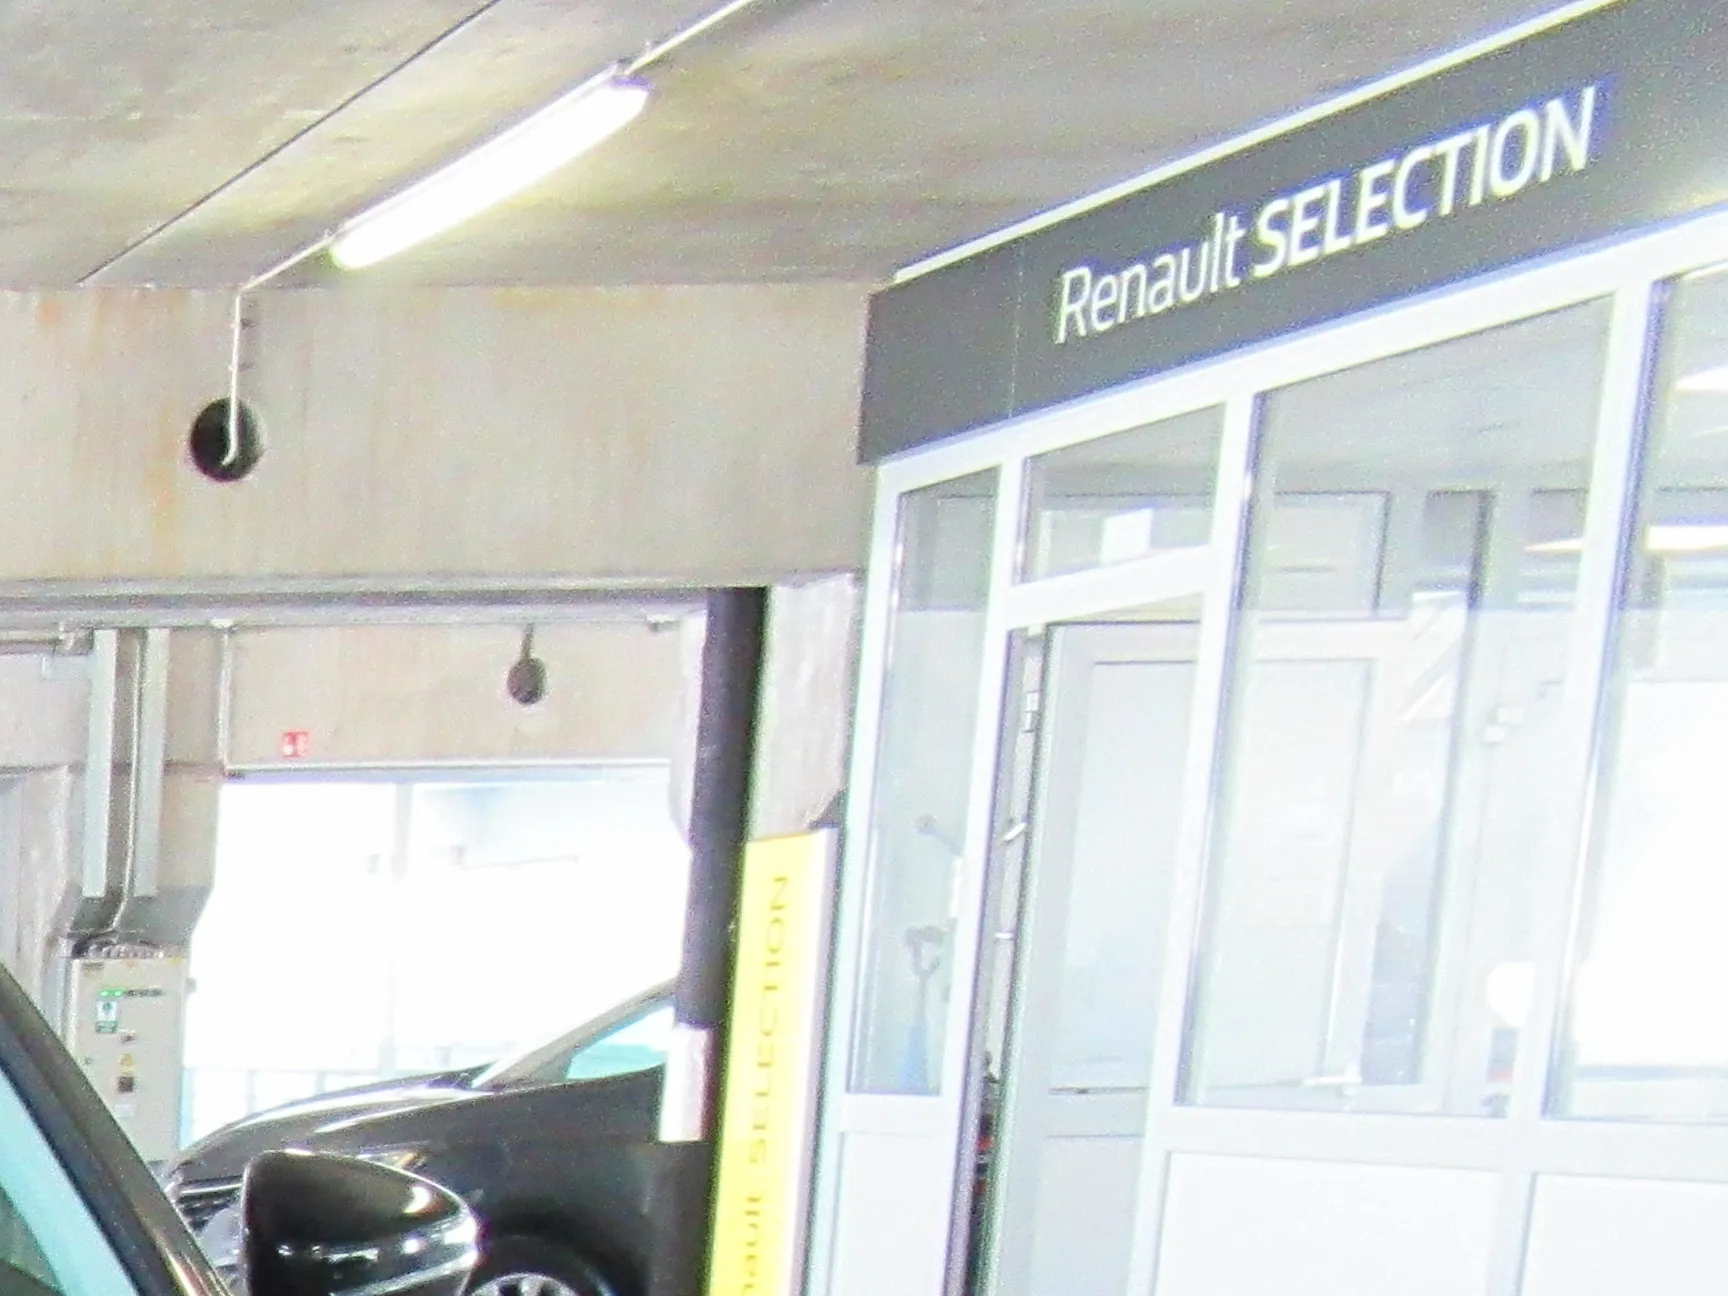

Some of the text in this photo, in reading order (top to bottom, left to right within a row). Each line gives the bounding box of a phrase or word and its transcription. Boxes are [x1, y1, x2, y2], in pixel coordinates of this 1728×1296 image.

[1053, 86, 1598, 345] Renault SELECTION
[748, 876, 789, 1165] SELECTION
